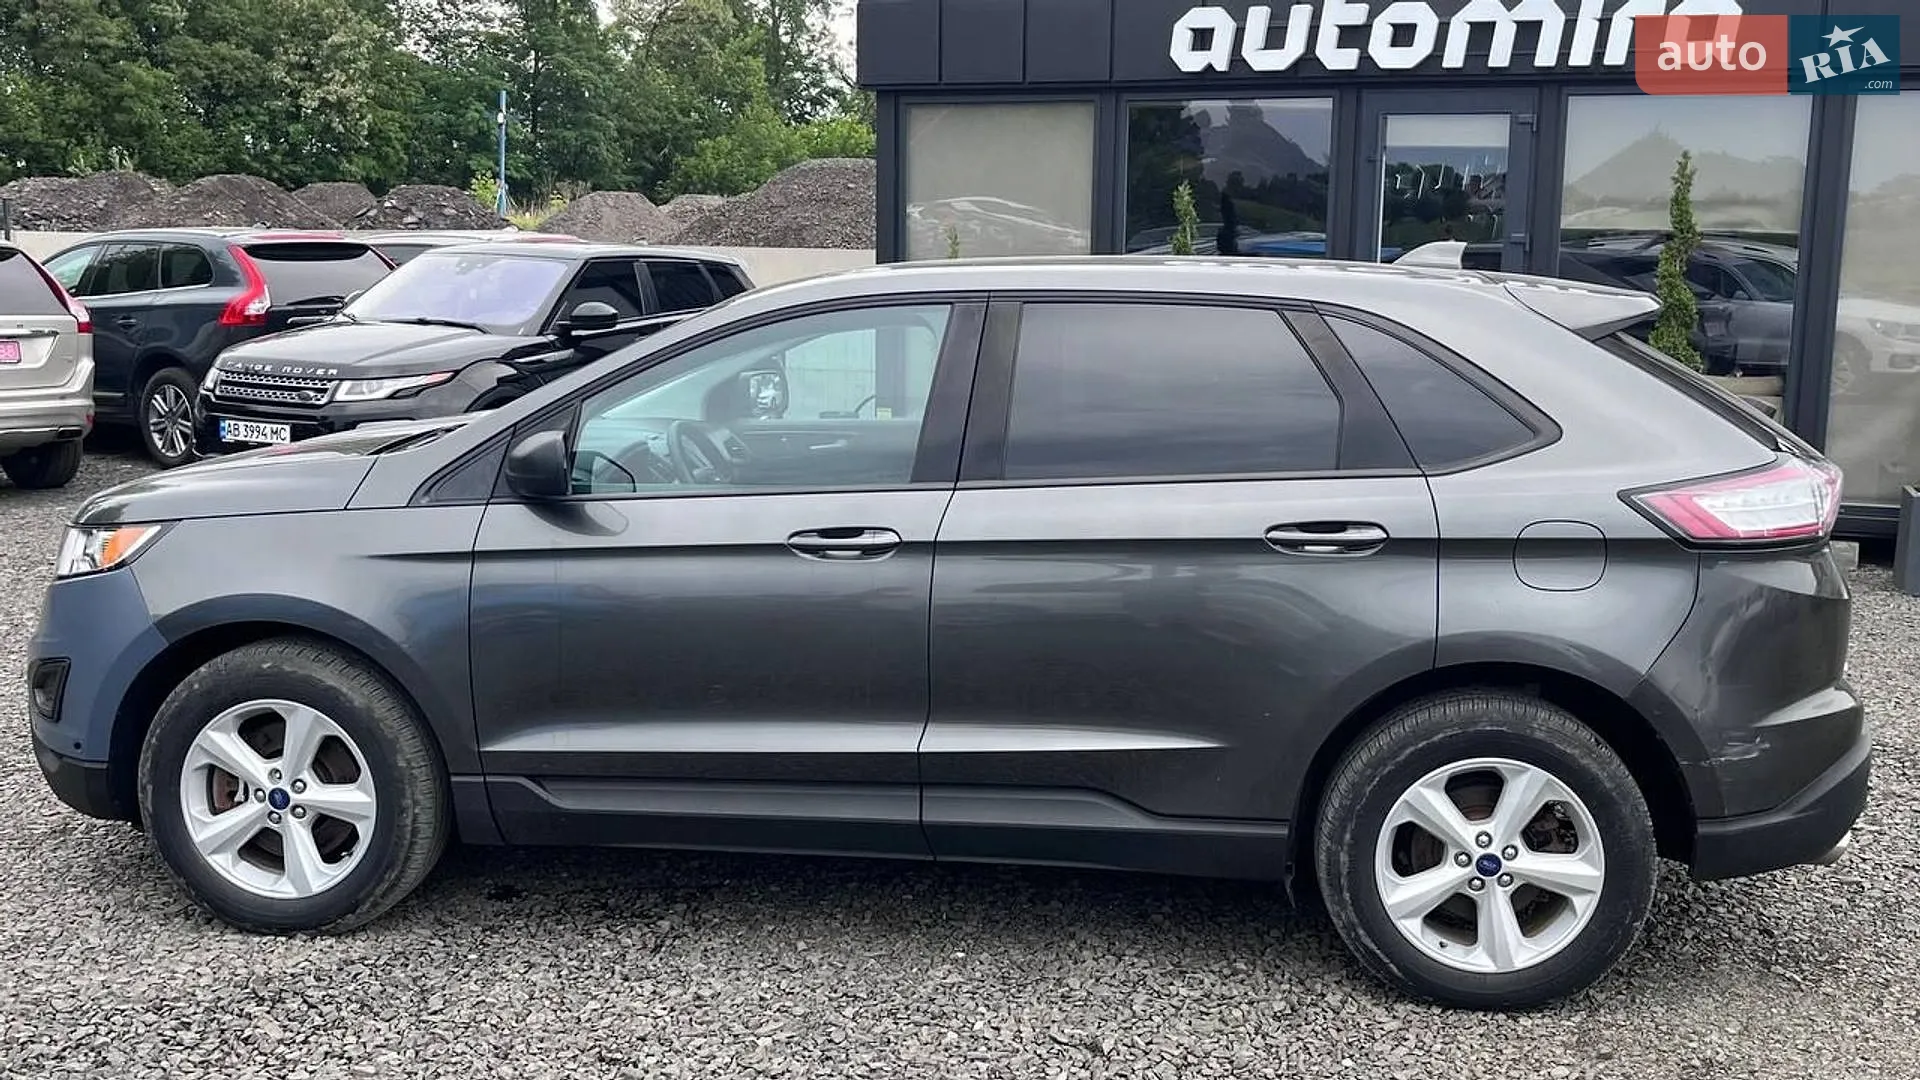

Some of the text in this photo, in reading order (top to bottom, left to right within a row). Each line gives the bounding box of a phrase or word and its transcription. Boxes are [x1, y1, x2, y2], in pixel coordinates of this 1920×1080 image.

[226, 422, 287, 441] AB 3994 MC
